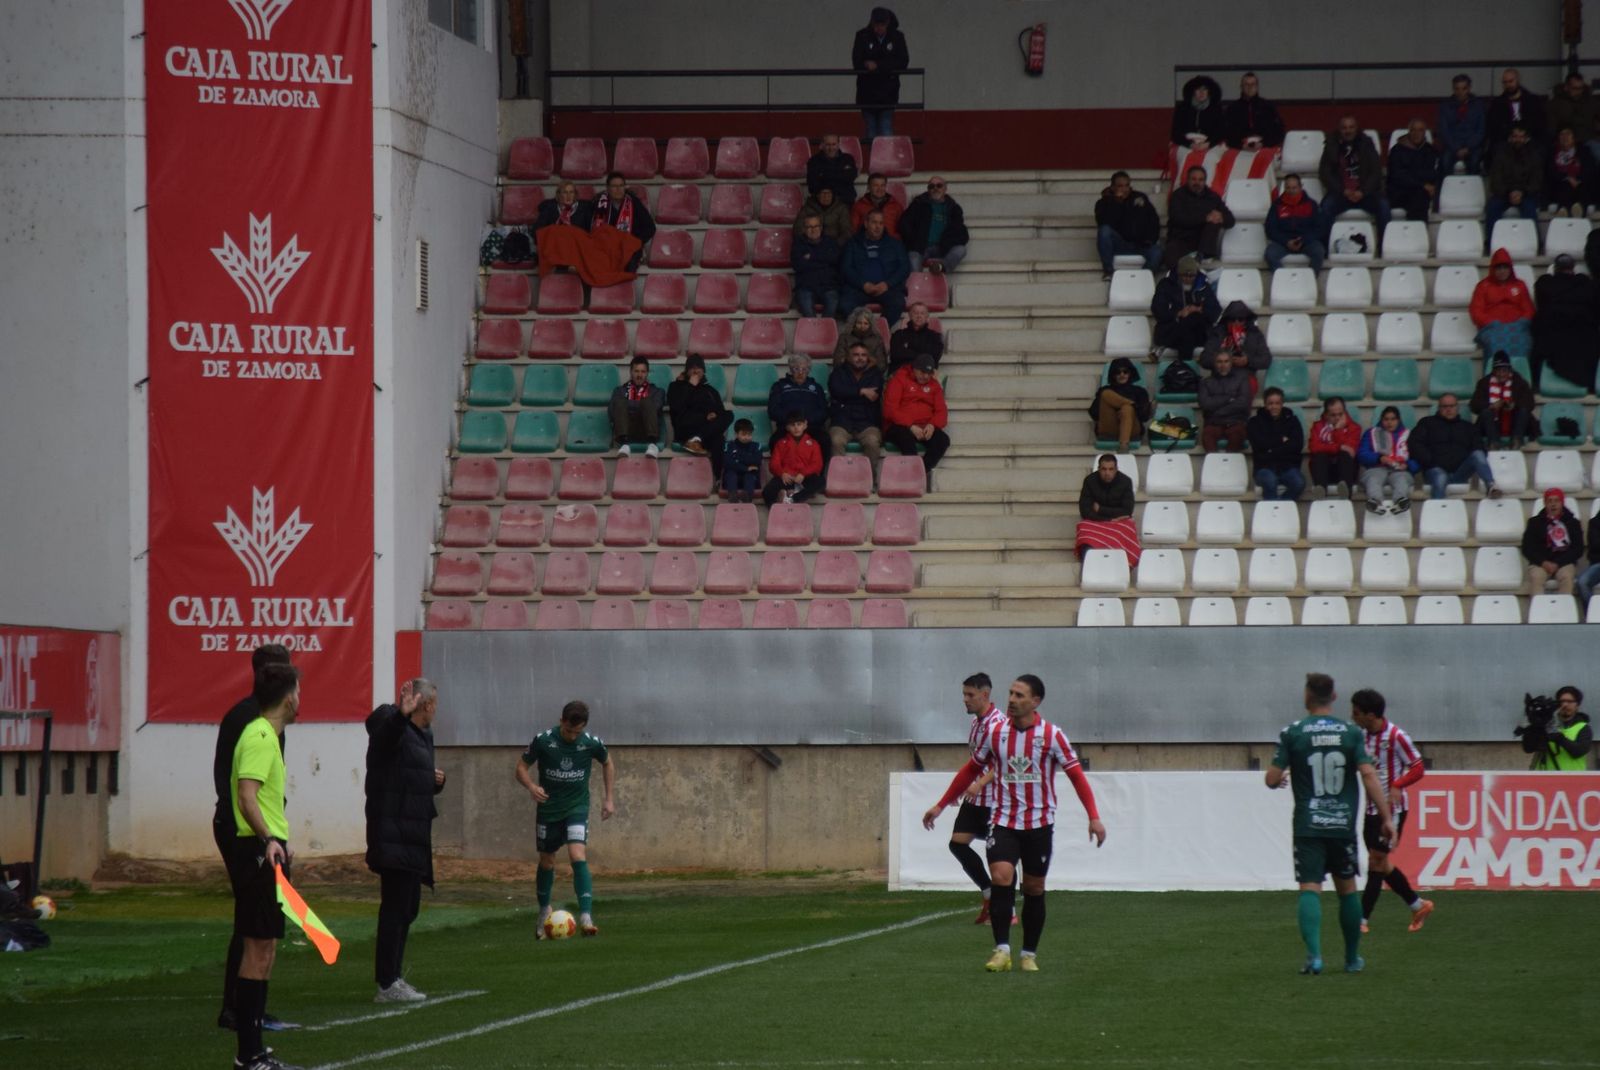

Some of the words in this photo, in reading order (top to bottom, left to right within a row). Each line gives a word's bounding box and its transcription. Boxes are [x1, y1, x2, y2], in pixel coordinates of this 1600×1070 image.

[165, 46, 240, 80] CAJA
[248, 50, 353, 85] RURAL
[198, 86, 226, 104] DE
[233, 88, 321, 109] ZAMORA
[168, 321, 244, 354] CAJA
[250, 325, 355, 356] RURAL
[202, 360, 230, 378] DE
[237, 361, 322, 380] ZAMORA
[168, 596, 243, 628] CAJA
[250, 598, 354, 627] RURAL
[200, 634, 229, 652] DE
[236, 634, 322, 652] ZAMORA
[1307, 751, 1346, 797] 16
